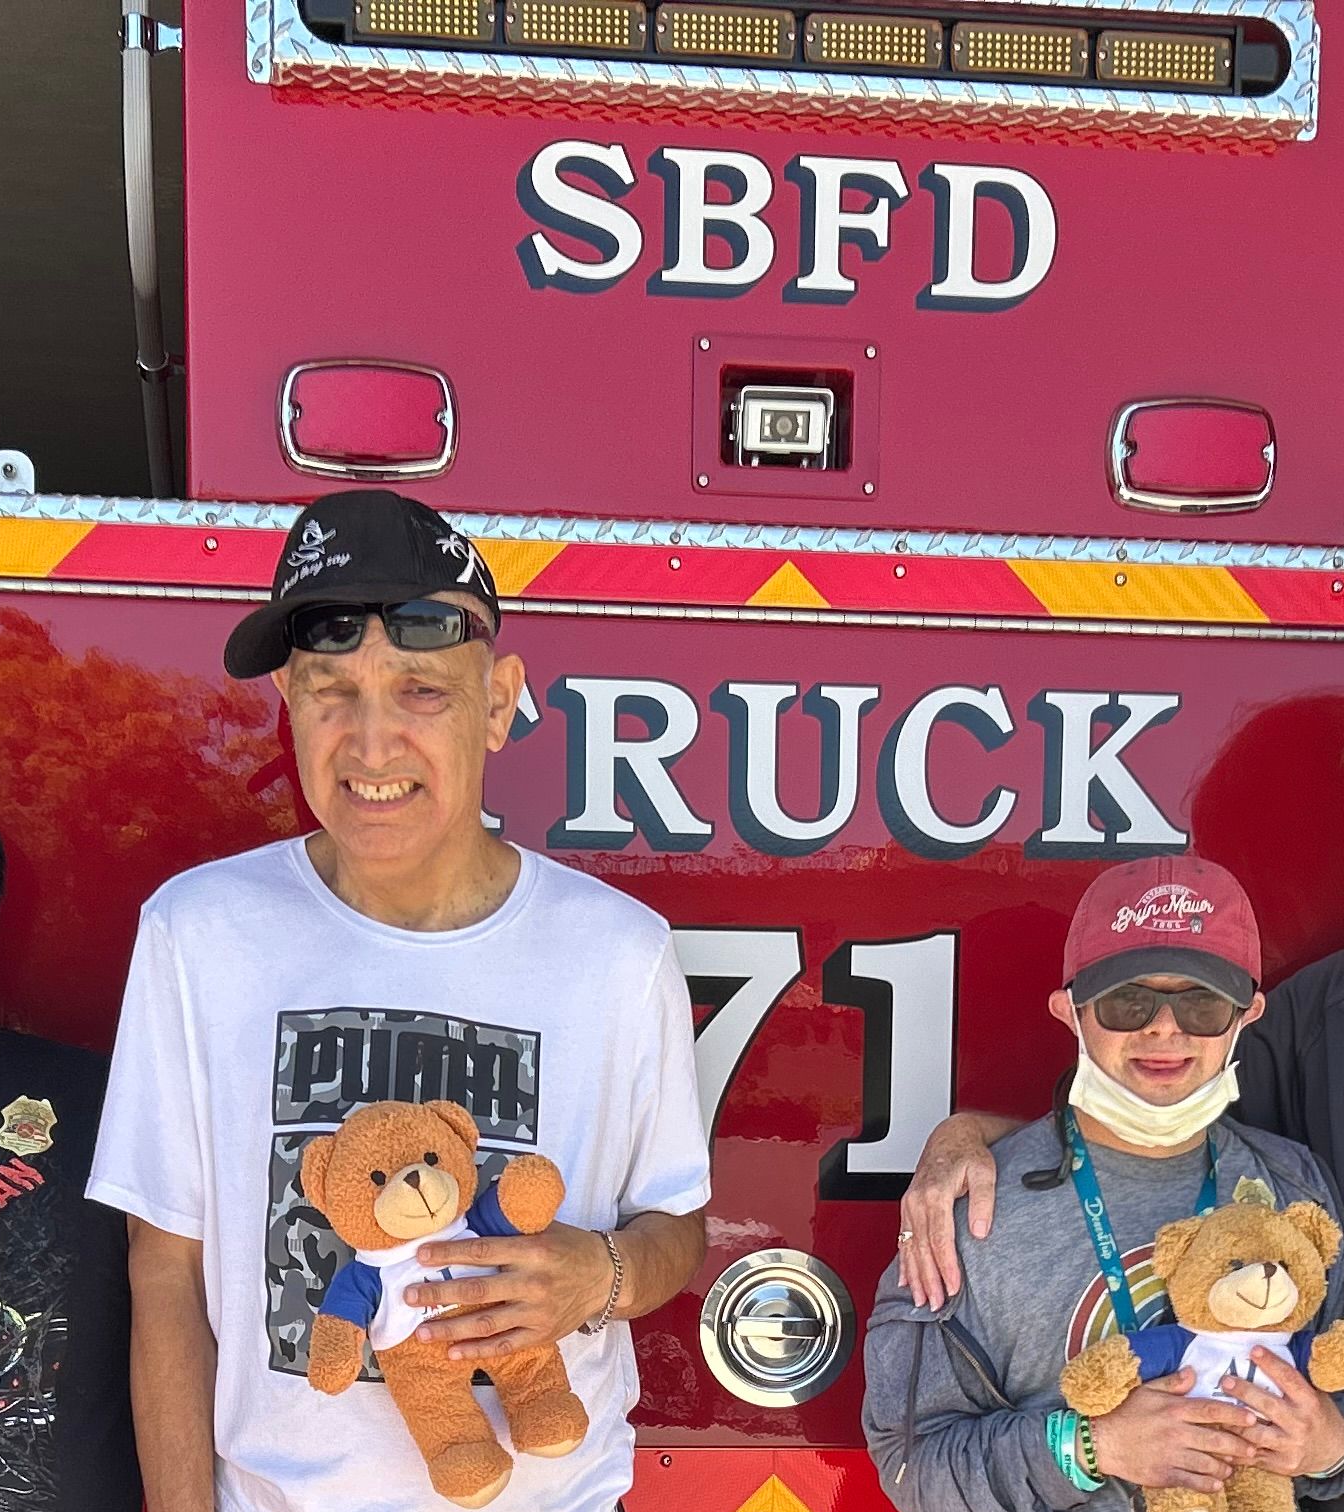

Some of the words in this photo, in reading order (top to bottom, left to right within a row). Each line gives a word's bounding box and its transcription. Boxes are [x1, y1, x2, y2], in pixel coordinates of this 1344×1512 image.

[516, 140, 1058, 312] SBFD
[481, 675, 1190, 861] RUCK
[1111, 905, 1161, 933] Bryn
[292, 1028, 519, 1120] PUMA
[670, 927, 960, 1199] 71
